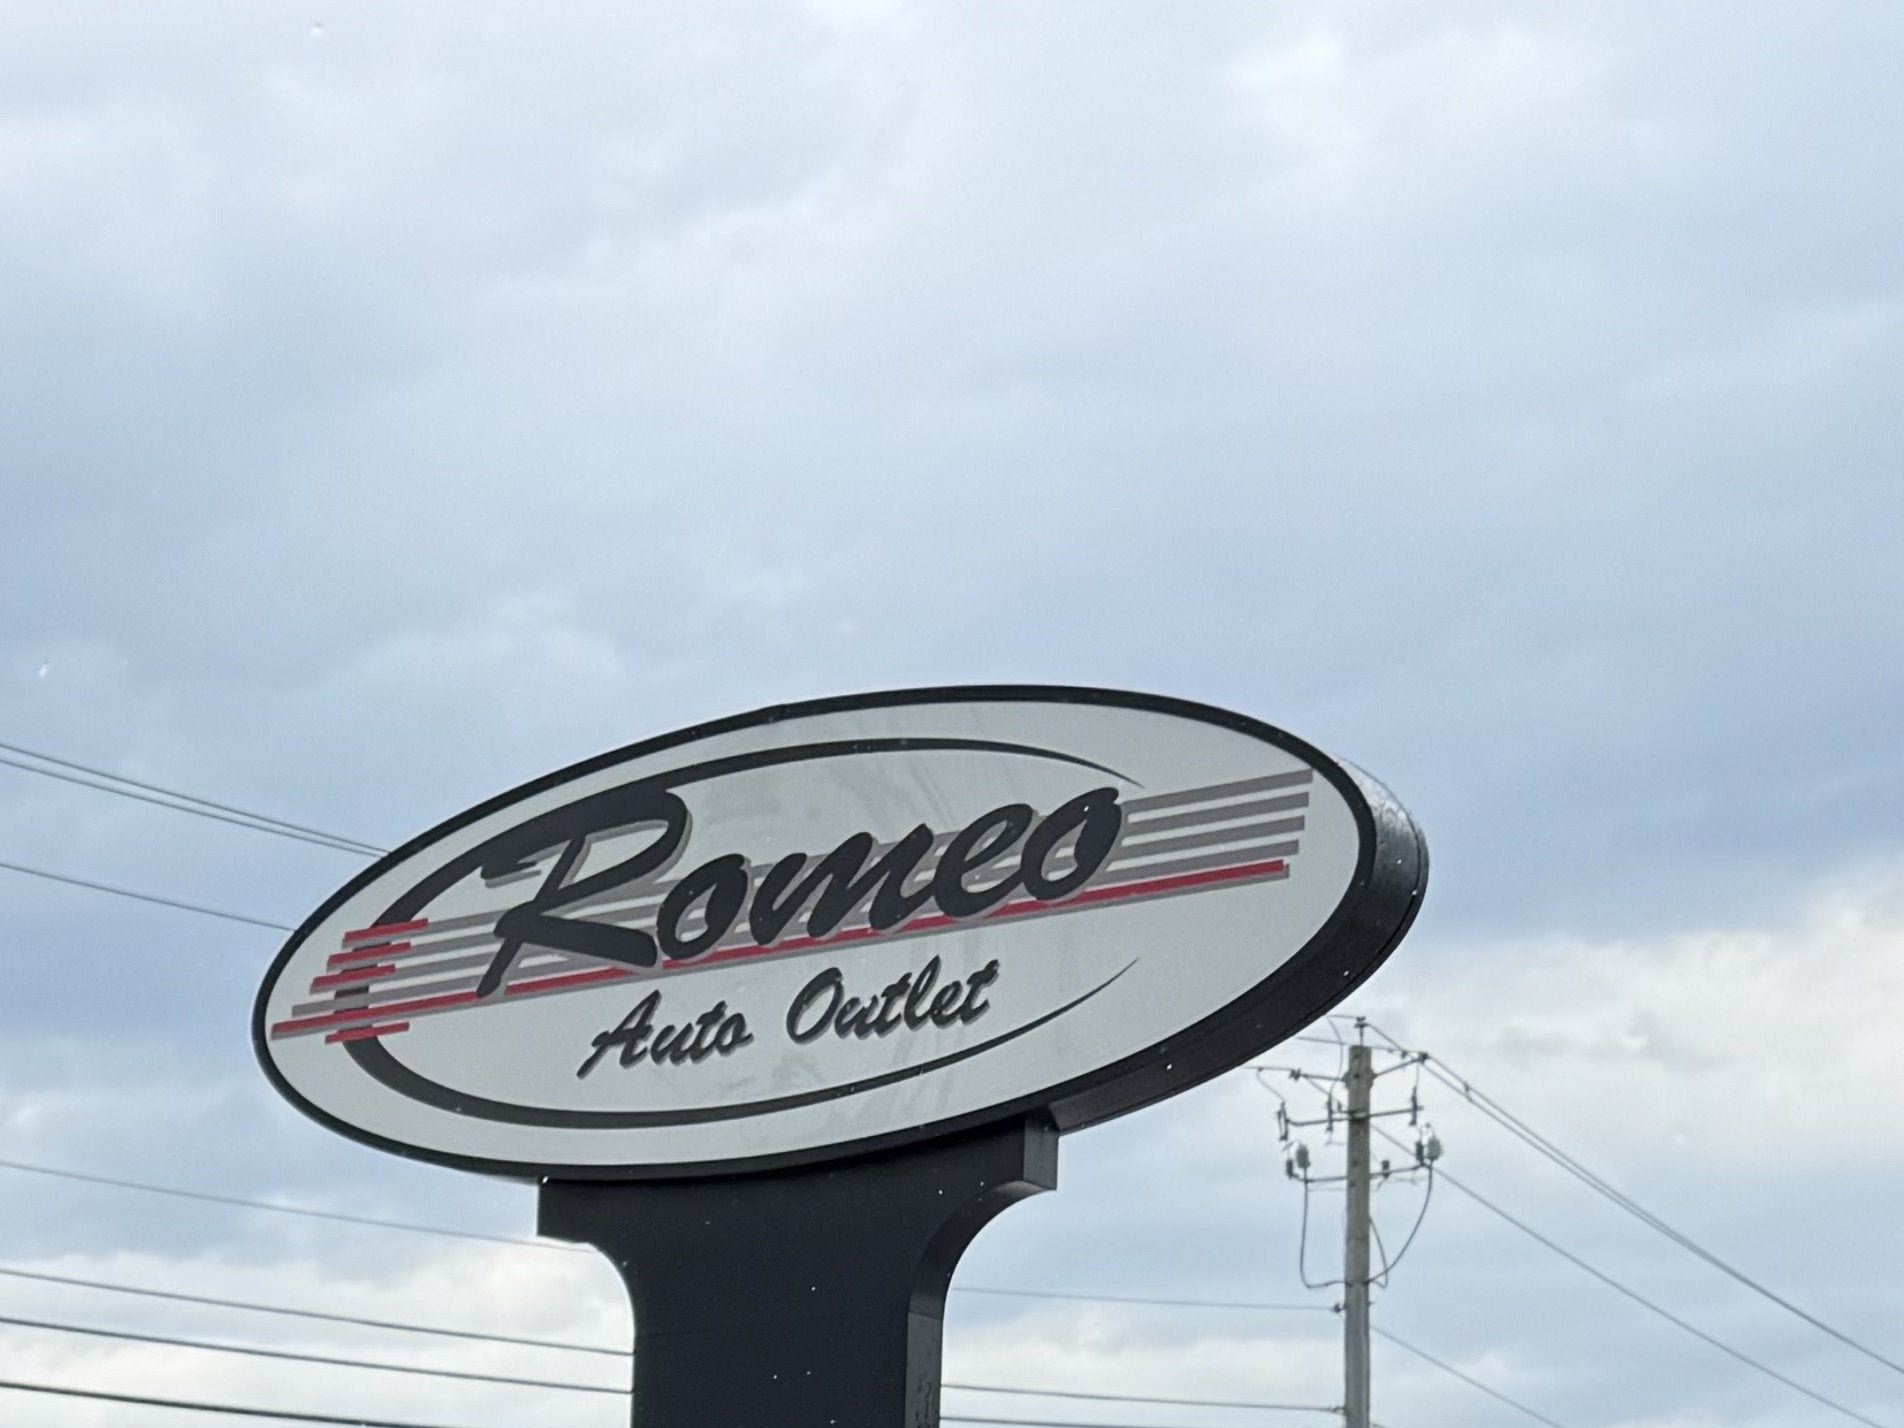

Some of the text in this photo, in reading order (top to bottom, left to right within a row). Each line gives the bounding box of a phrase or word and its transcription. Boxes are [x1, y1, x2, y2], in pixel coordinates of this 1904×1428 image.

[476, 785, 1124, 997] Romeo
[578, 955, 1000, 1081] Auto Outlet
